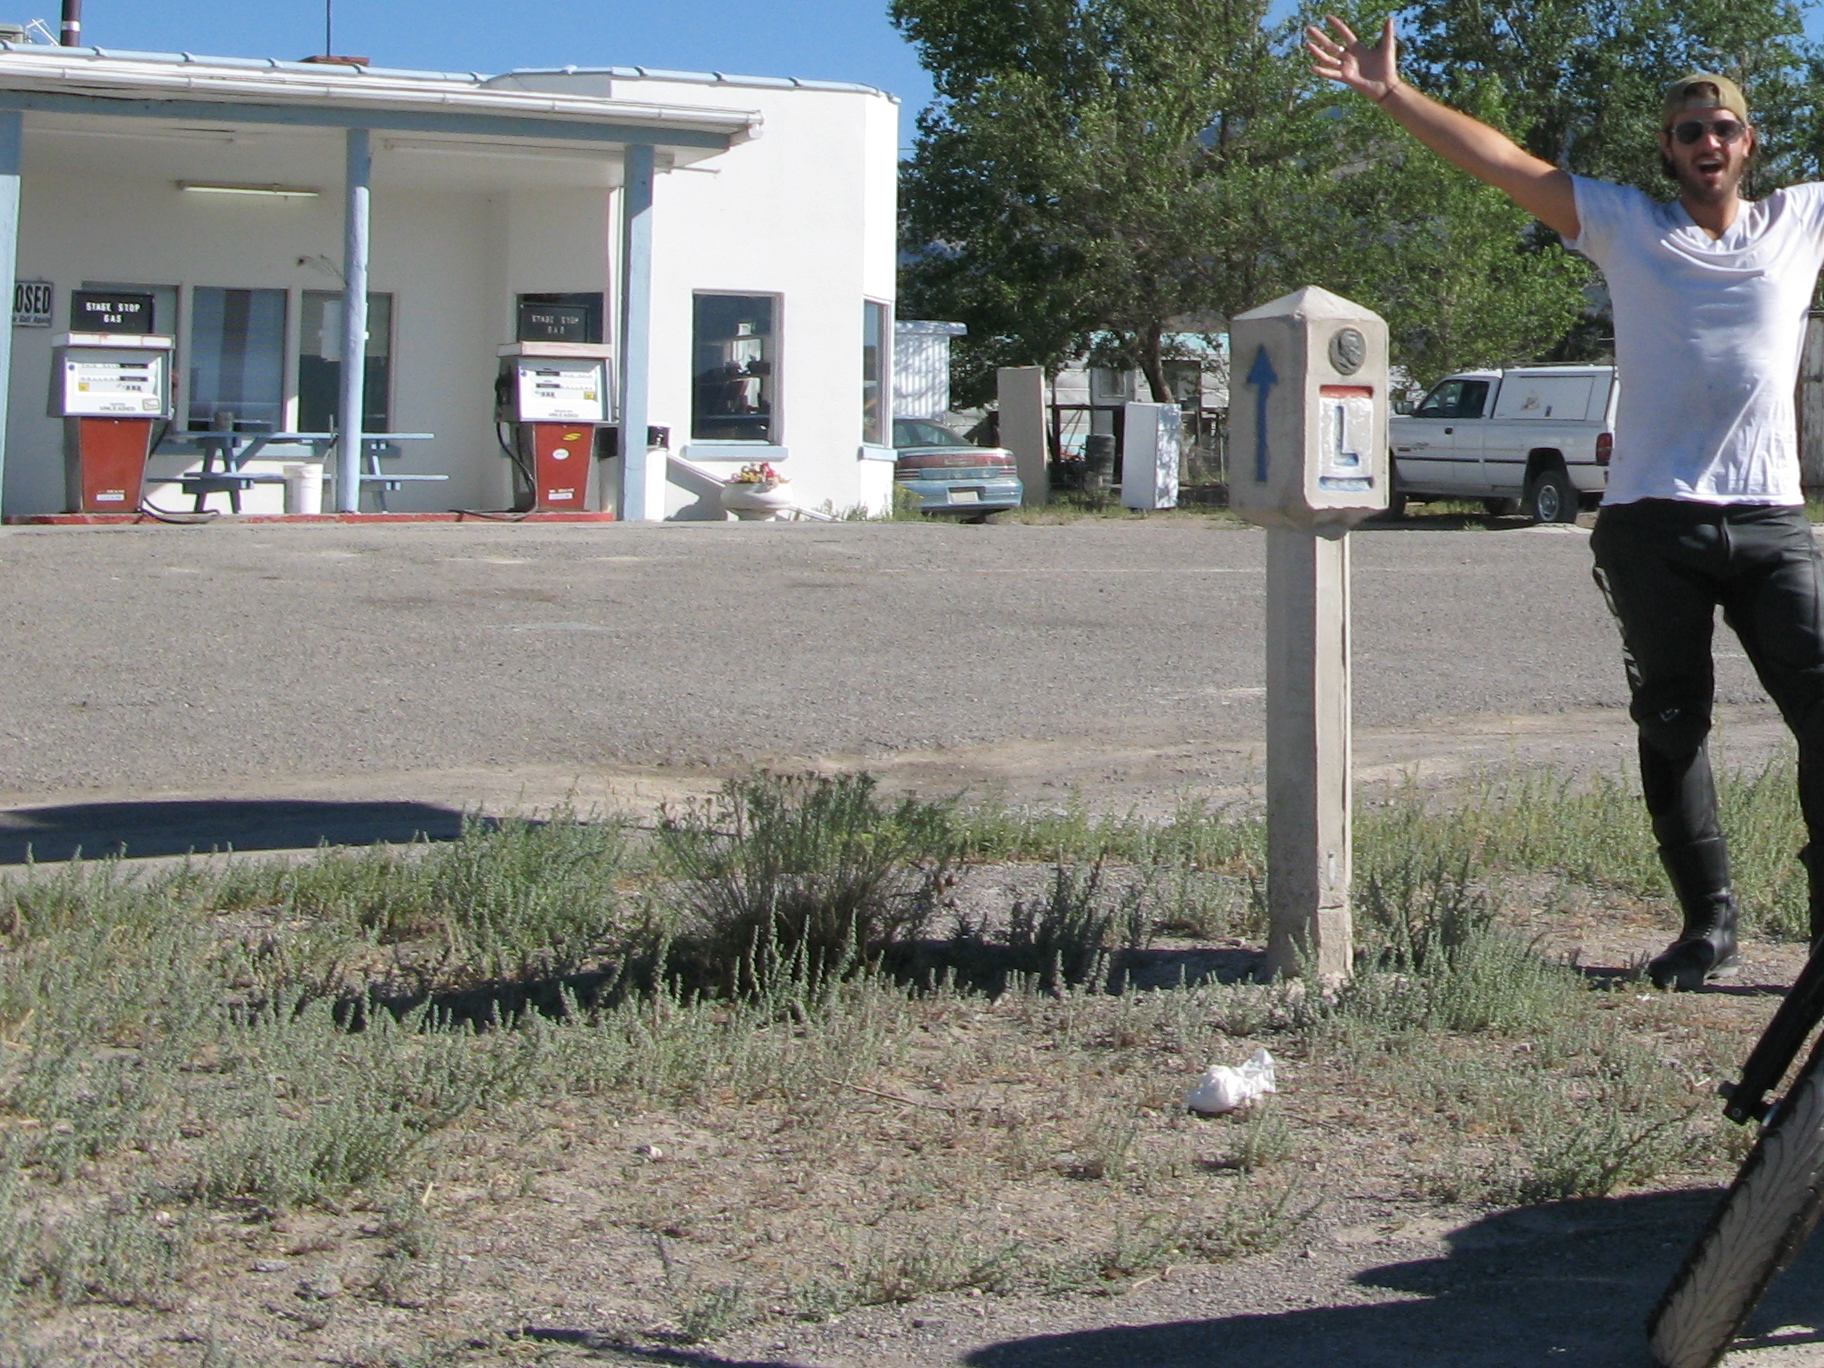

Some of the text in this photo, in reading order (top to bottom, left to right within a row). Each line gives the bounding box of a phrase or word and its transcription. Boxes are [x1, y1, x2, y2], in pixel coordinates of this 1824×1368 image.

[15, 284, 51, 313] OSED
[86, 302, 140, 312] STAGE STOP
[104, 314, 122, 323] GAS
[1333, 406, 1360, 466] L
